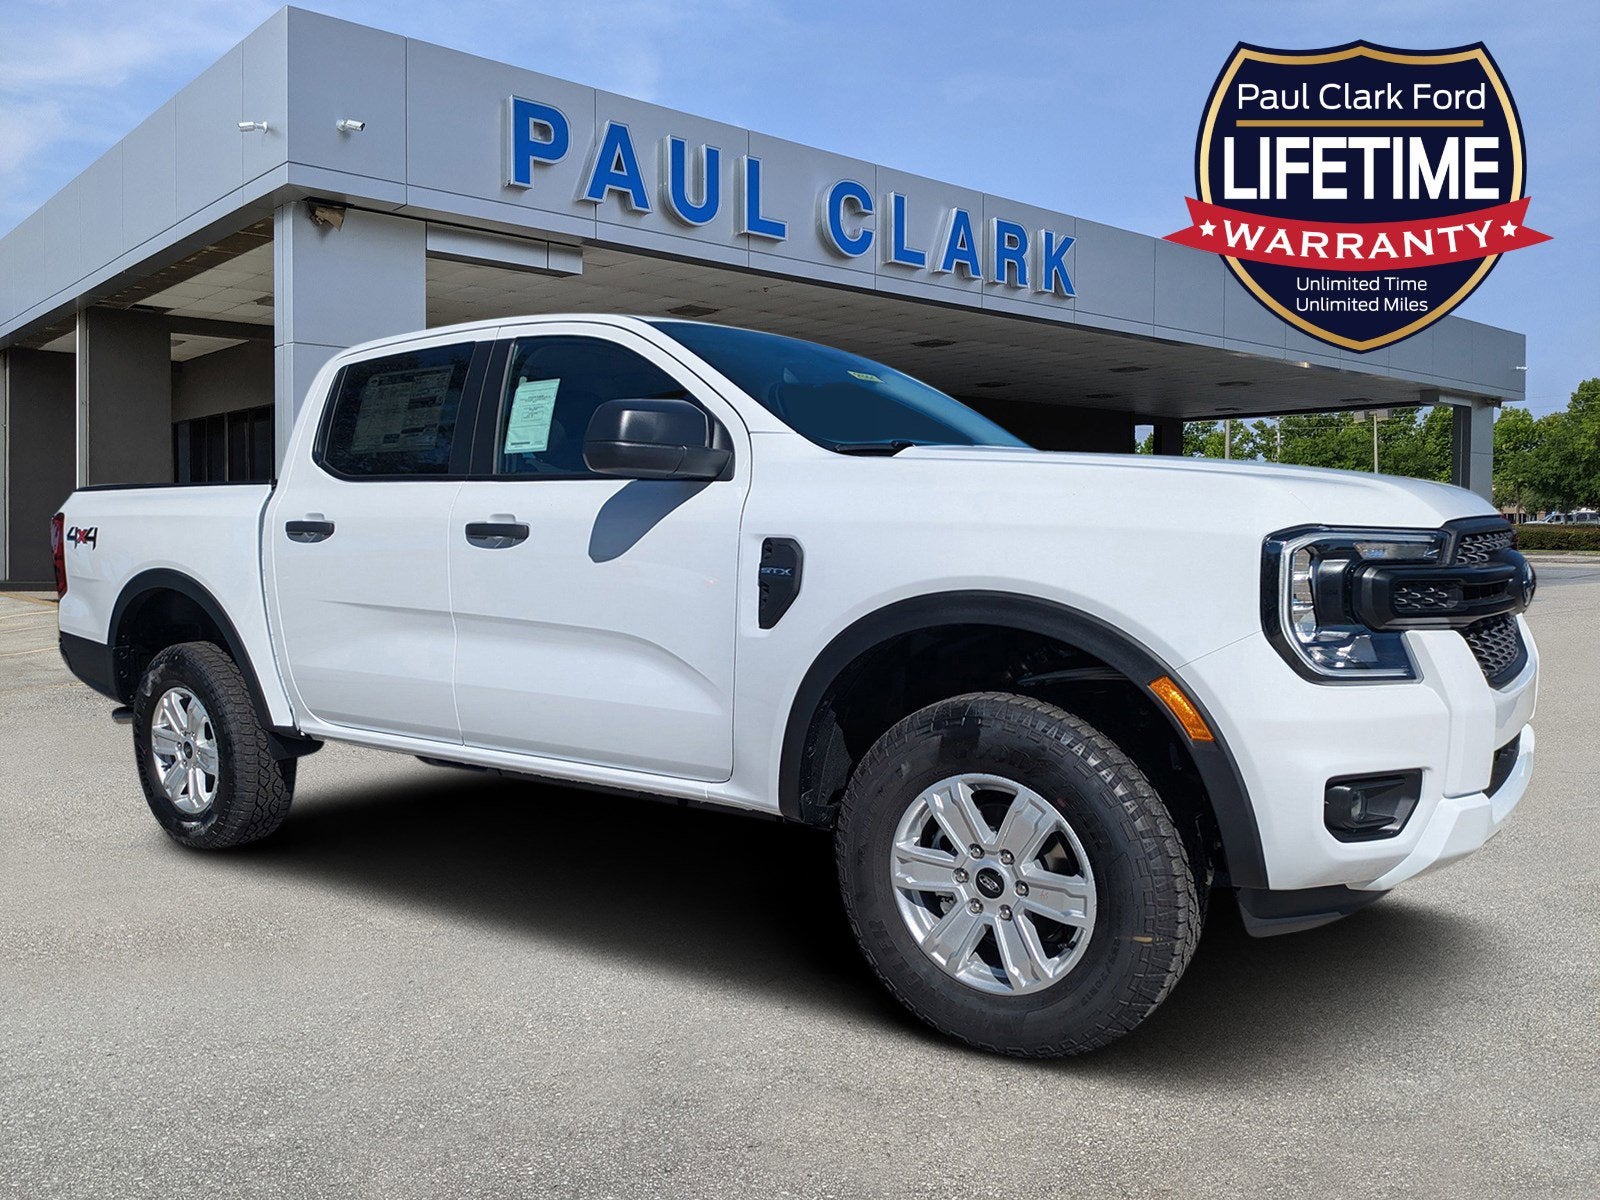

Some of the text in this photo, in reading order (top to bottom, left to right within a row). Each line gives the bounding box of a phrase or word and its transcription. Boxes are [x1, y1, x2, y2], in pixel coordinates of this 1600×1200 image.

[506, 95, 1077, 298] PAUL CLARK
[66, 526, 98, 550] 4x4
[761, 567, 792, 576] STX
